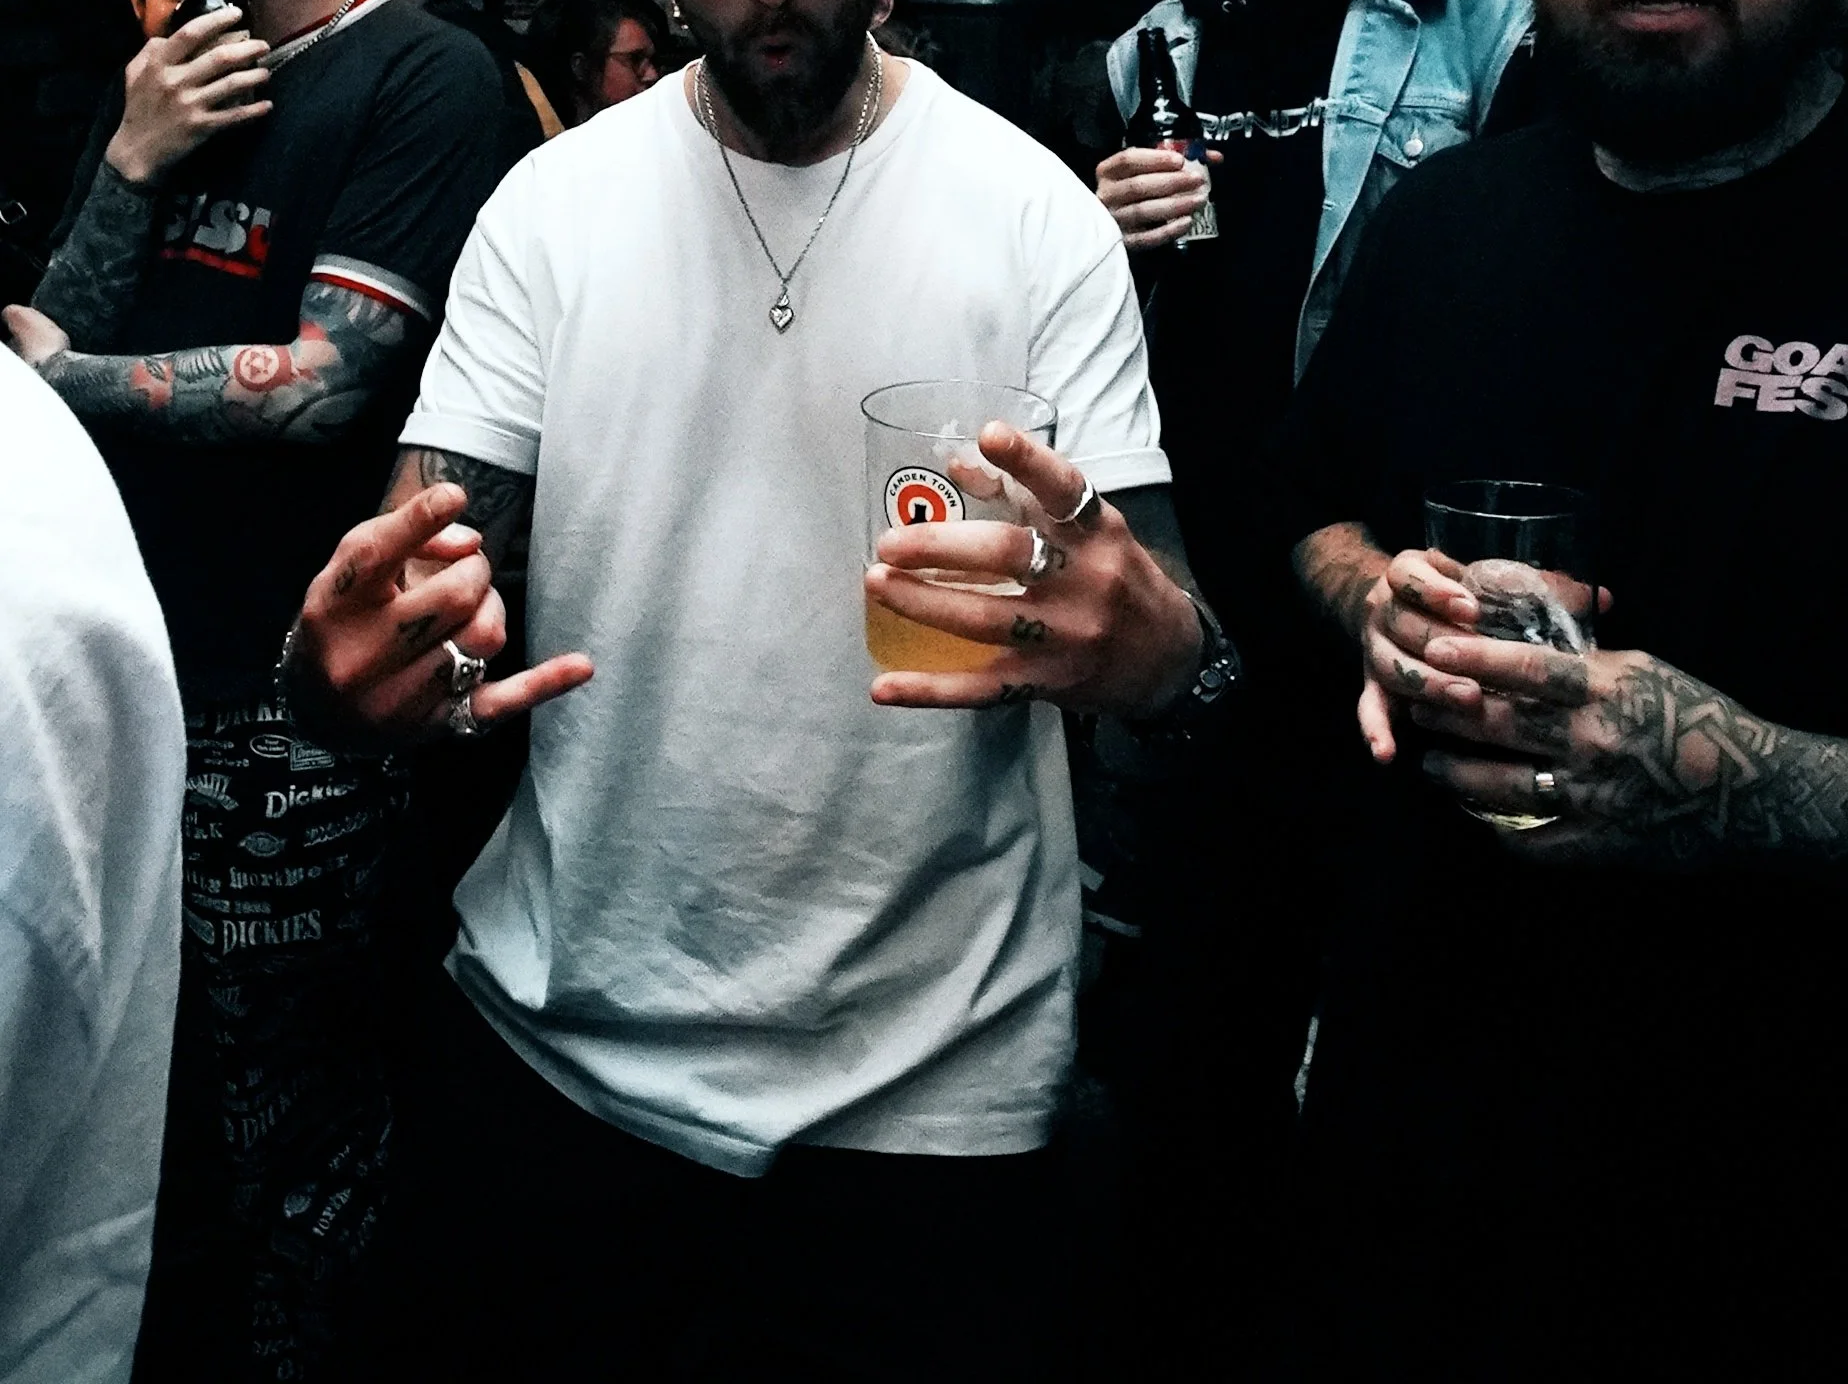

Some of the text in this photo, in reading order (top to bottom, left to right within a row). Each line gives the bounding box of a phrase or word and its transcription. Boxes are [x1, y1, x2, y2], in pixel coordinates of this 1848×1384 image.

[1714, 367, 1848, 422] FES
[889, 472, 957, 509] CAMDEN TOWN
[221, 907, 323, 956] DICKIES
